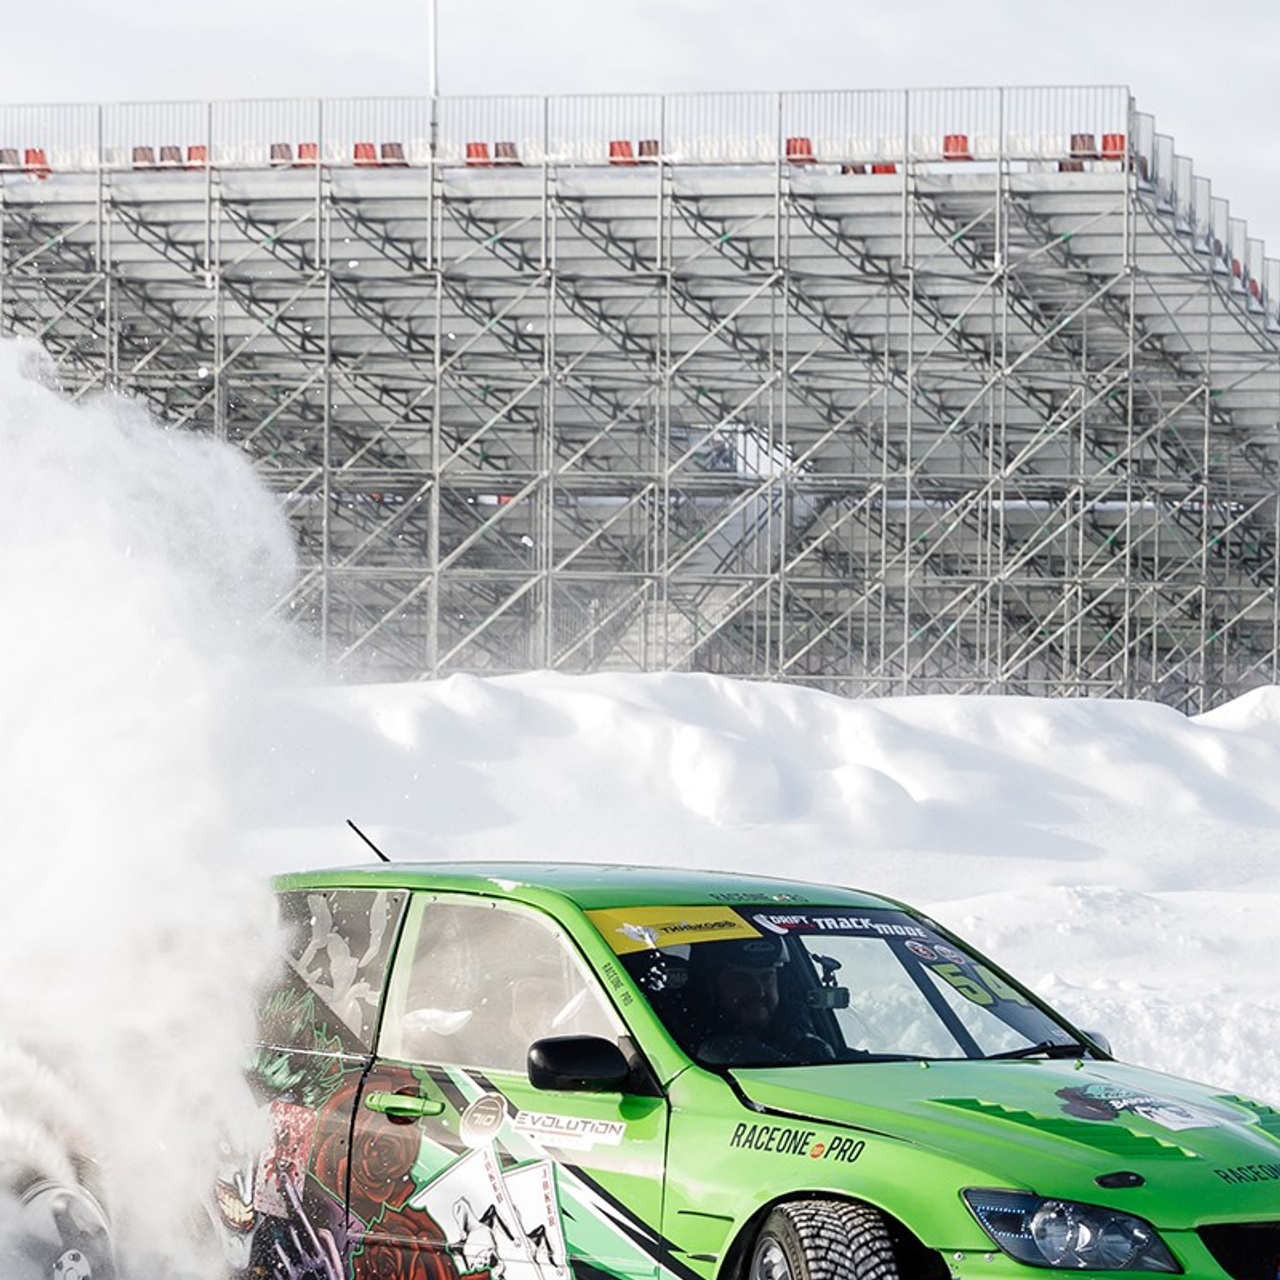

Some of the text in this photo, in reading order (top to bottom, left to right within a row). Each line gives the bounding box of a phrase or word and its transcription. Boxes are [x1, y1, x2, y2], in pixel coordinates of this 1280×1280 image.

[769, 915, 809, 924] DRIFT
[812, 917, 928, 938] TRACK MODE
[930, 963, 1030, 1006] 54
[516, 1112, 624, 1136] EVOLUTION
[730, 1122, 866, 1163] RACEONE PRO
